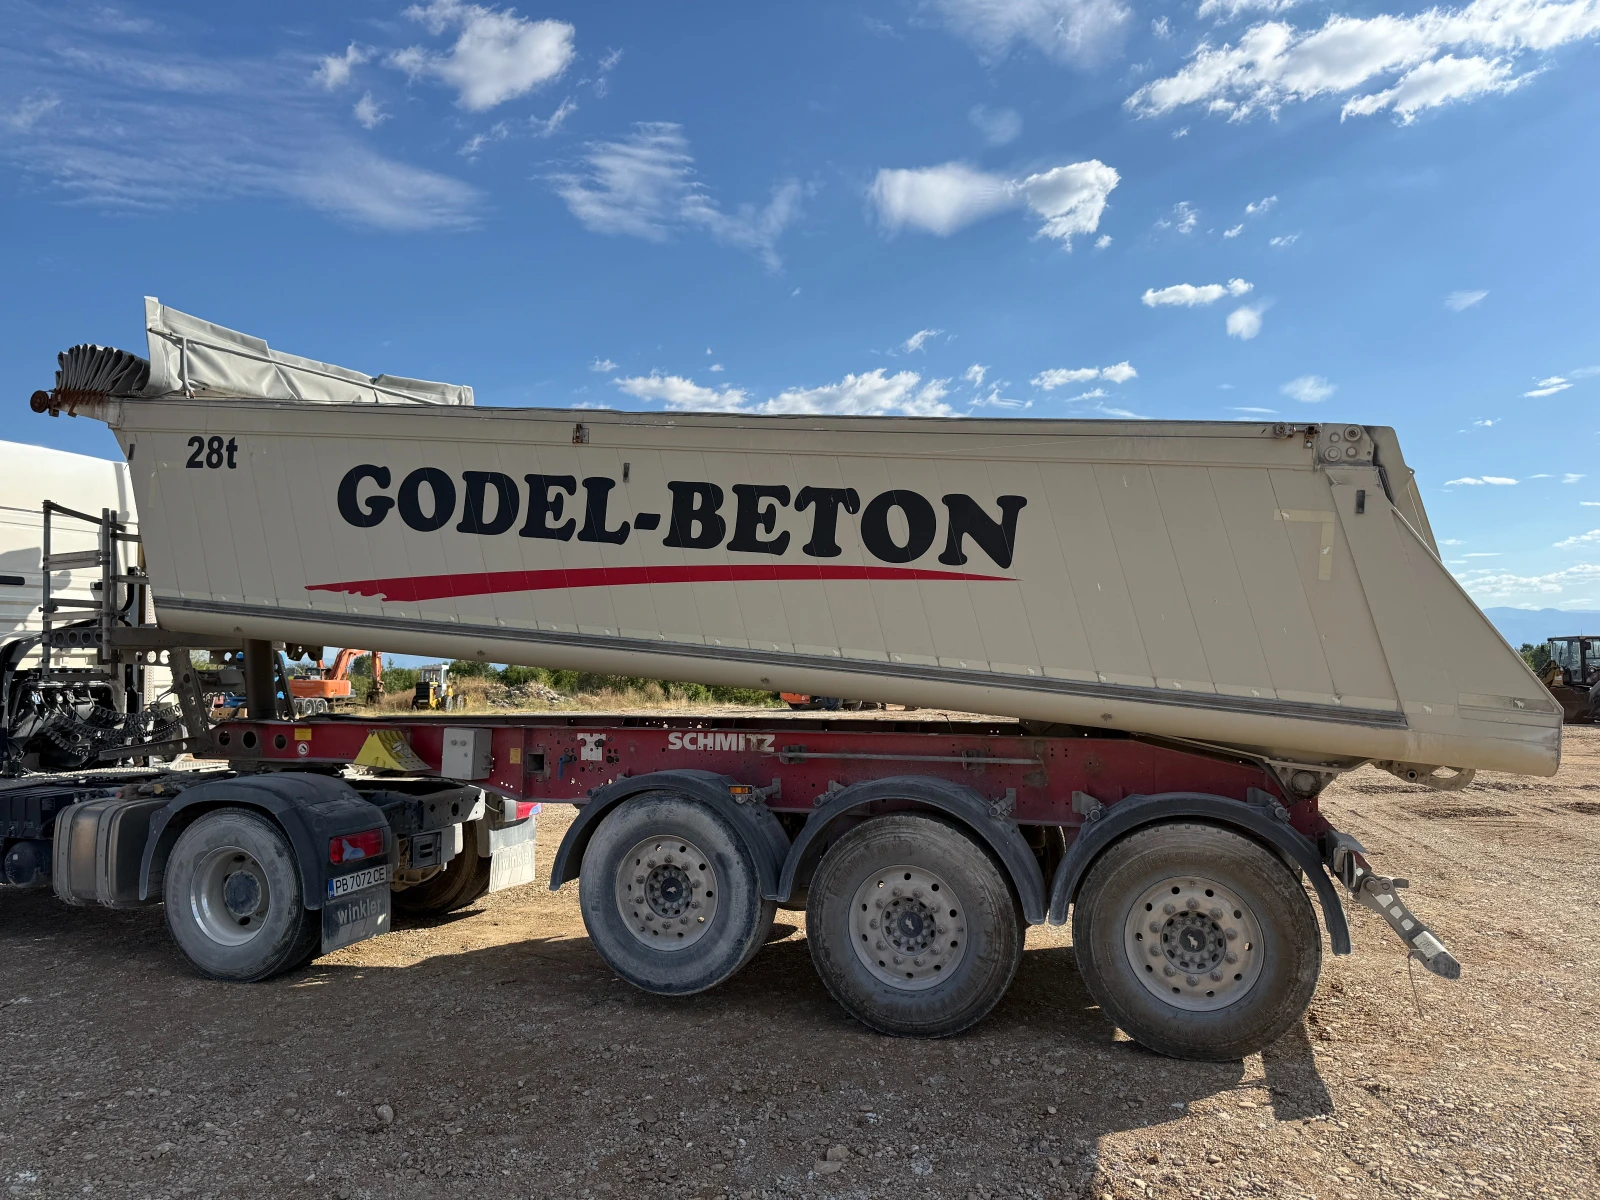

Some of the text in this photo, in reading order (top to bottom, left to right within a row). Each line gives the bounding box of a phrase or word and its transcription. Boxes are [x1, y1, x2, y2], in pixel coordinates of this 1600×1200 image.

[185, 435, 238, 469] 28t
[337, 464, 1027, 569] GODEL-BETON
[668, 732, 775, 752] SCHMITZ
[335, 866, 387, 894] PB 7072 CE
[338, 899, 382, 924] winkler
